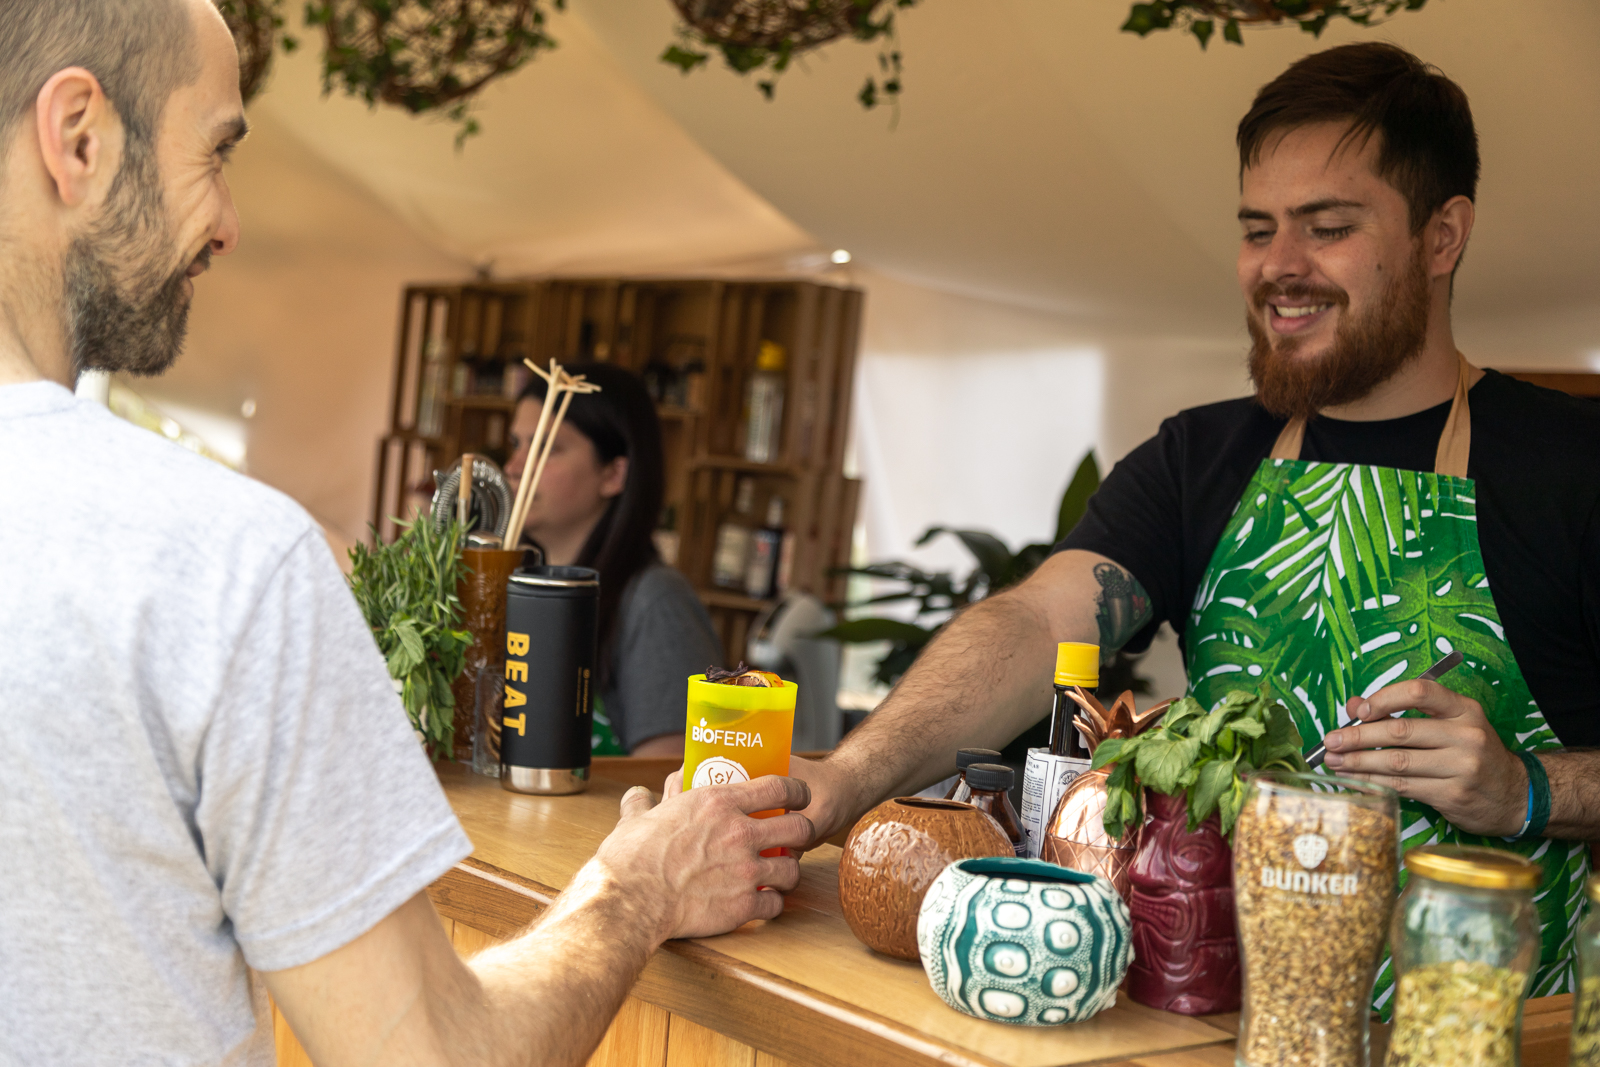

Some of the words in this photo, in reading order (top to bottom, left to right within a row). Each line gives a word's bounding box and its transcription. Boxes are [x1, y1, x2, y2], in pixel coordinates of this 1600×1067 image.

[503, 631, 530, 737] BEAT
[692, 722, 763, 748] BIOFERIA
[1261, 866, 1358, 896] BUNKER
